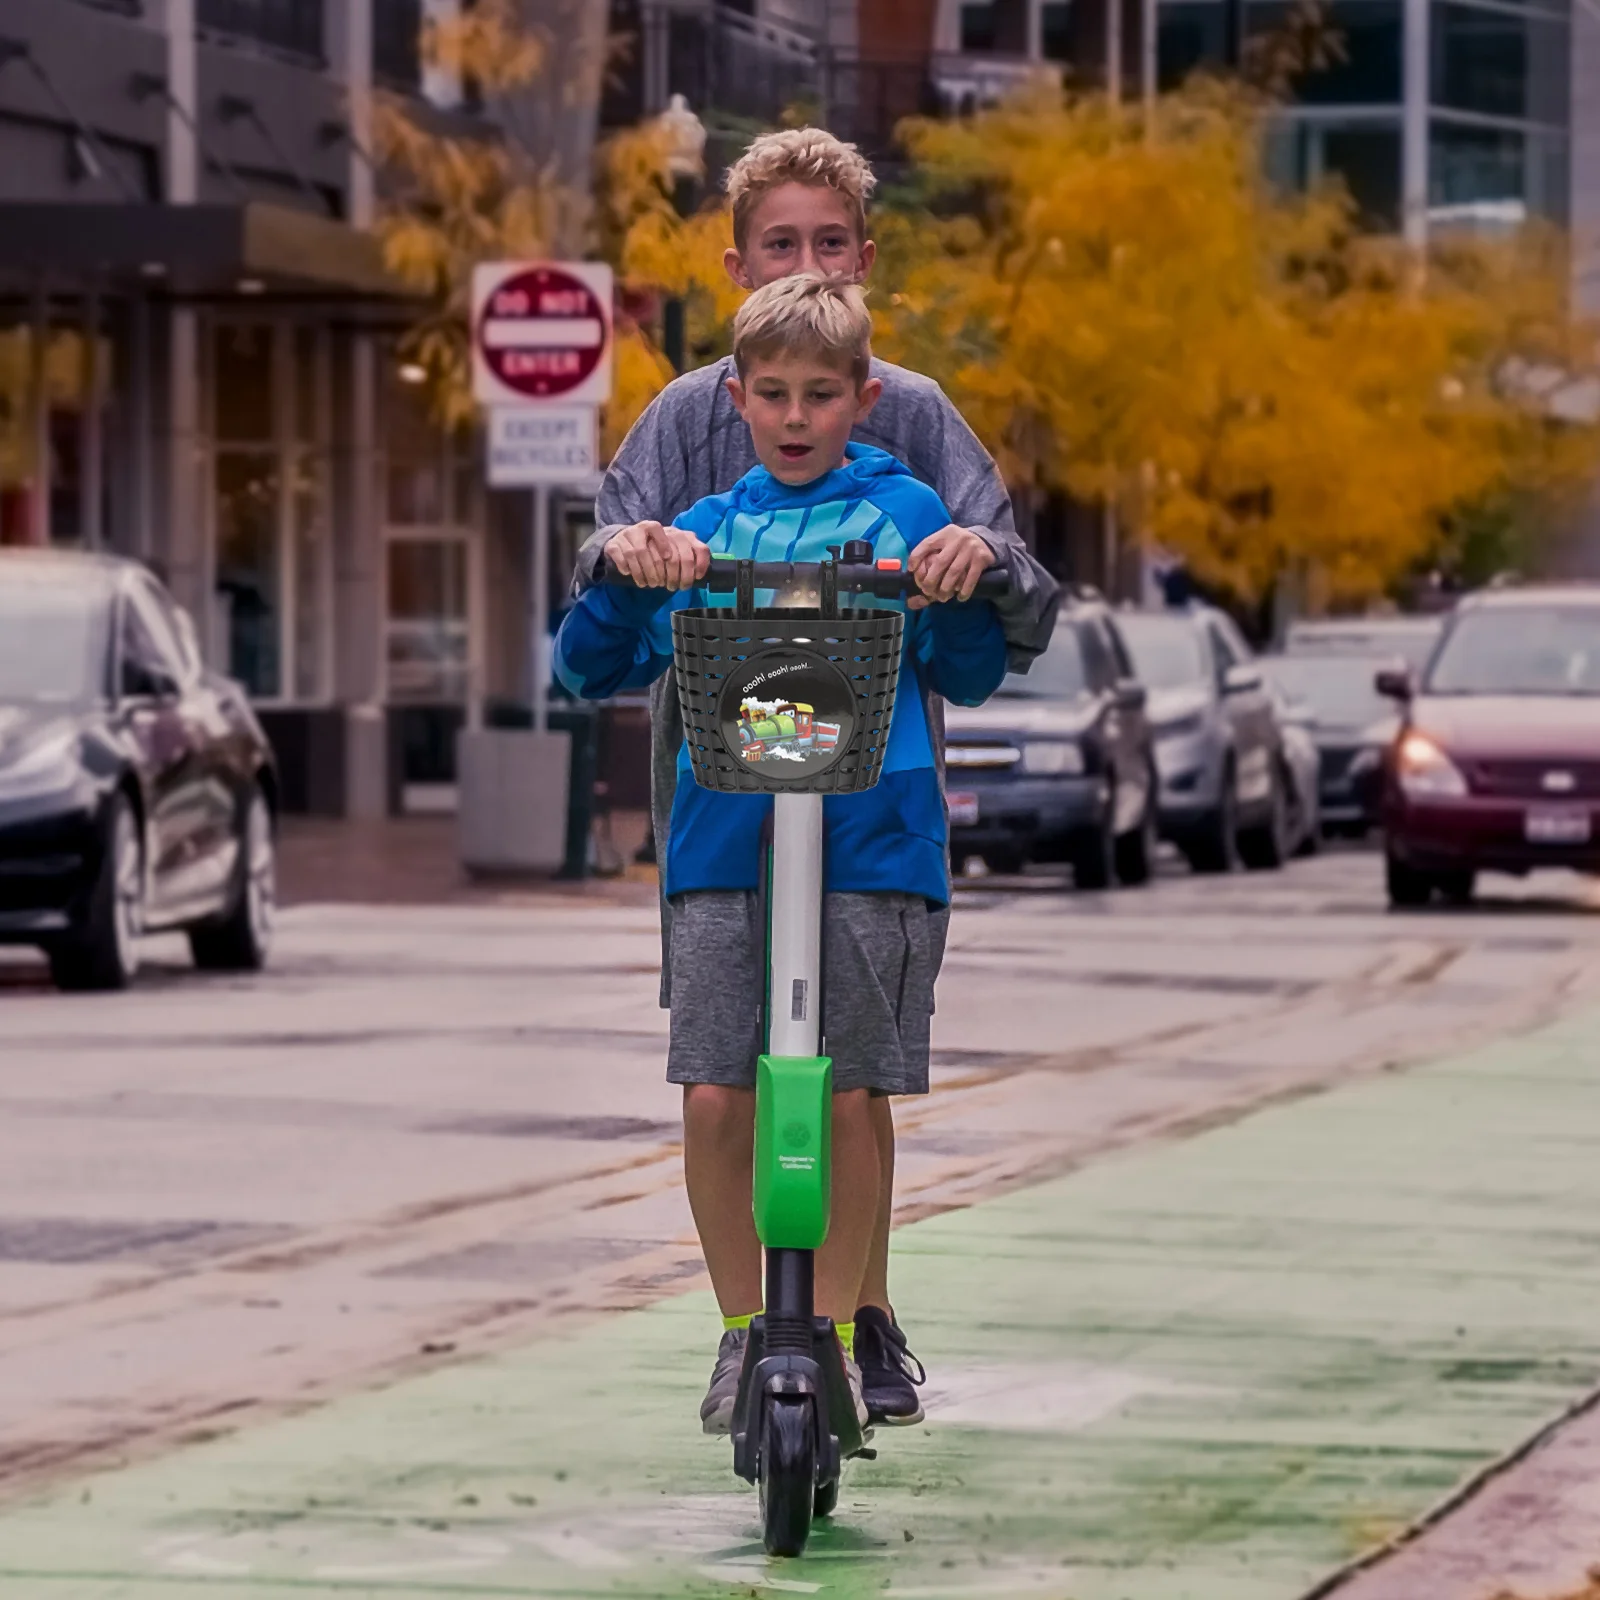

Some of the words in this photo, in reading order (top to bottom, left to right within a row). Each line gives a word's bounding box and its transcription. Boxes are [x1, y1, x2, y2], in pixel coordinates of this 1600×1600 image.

[494, 290, 529, 313] DO
[540, 290, 588, 313] NOT
[502, 352, 580, 375] ENTER
[505, 419, 578, 439] EXCEPT
[493, 447, 591, 467] BICYCLES
[742, 672, 767, 693] oooh!
[767, 664, 789, 679] oooh!
